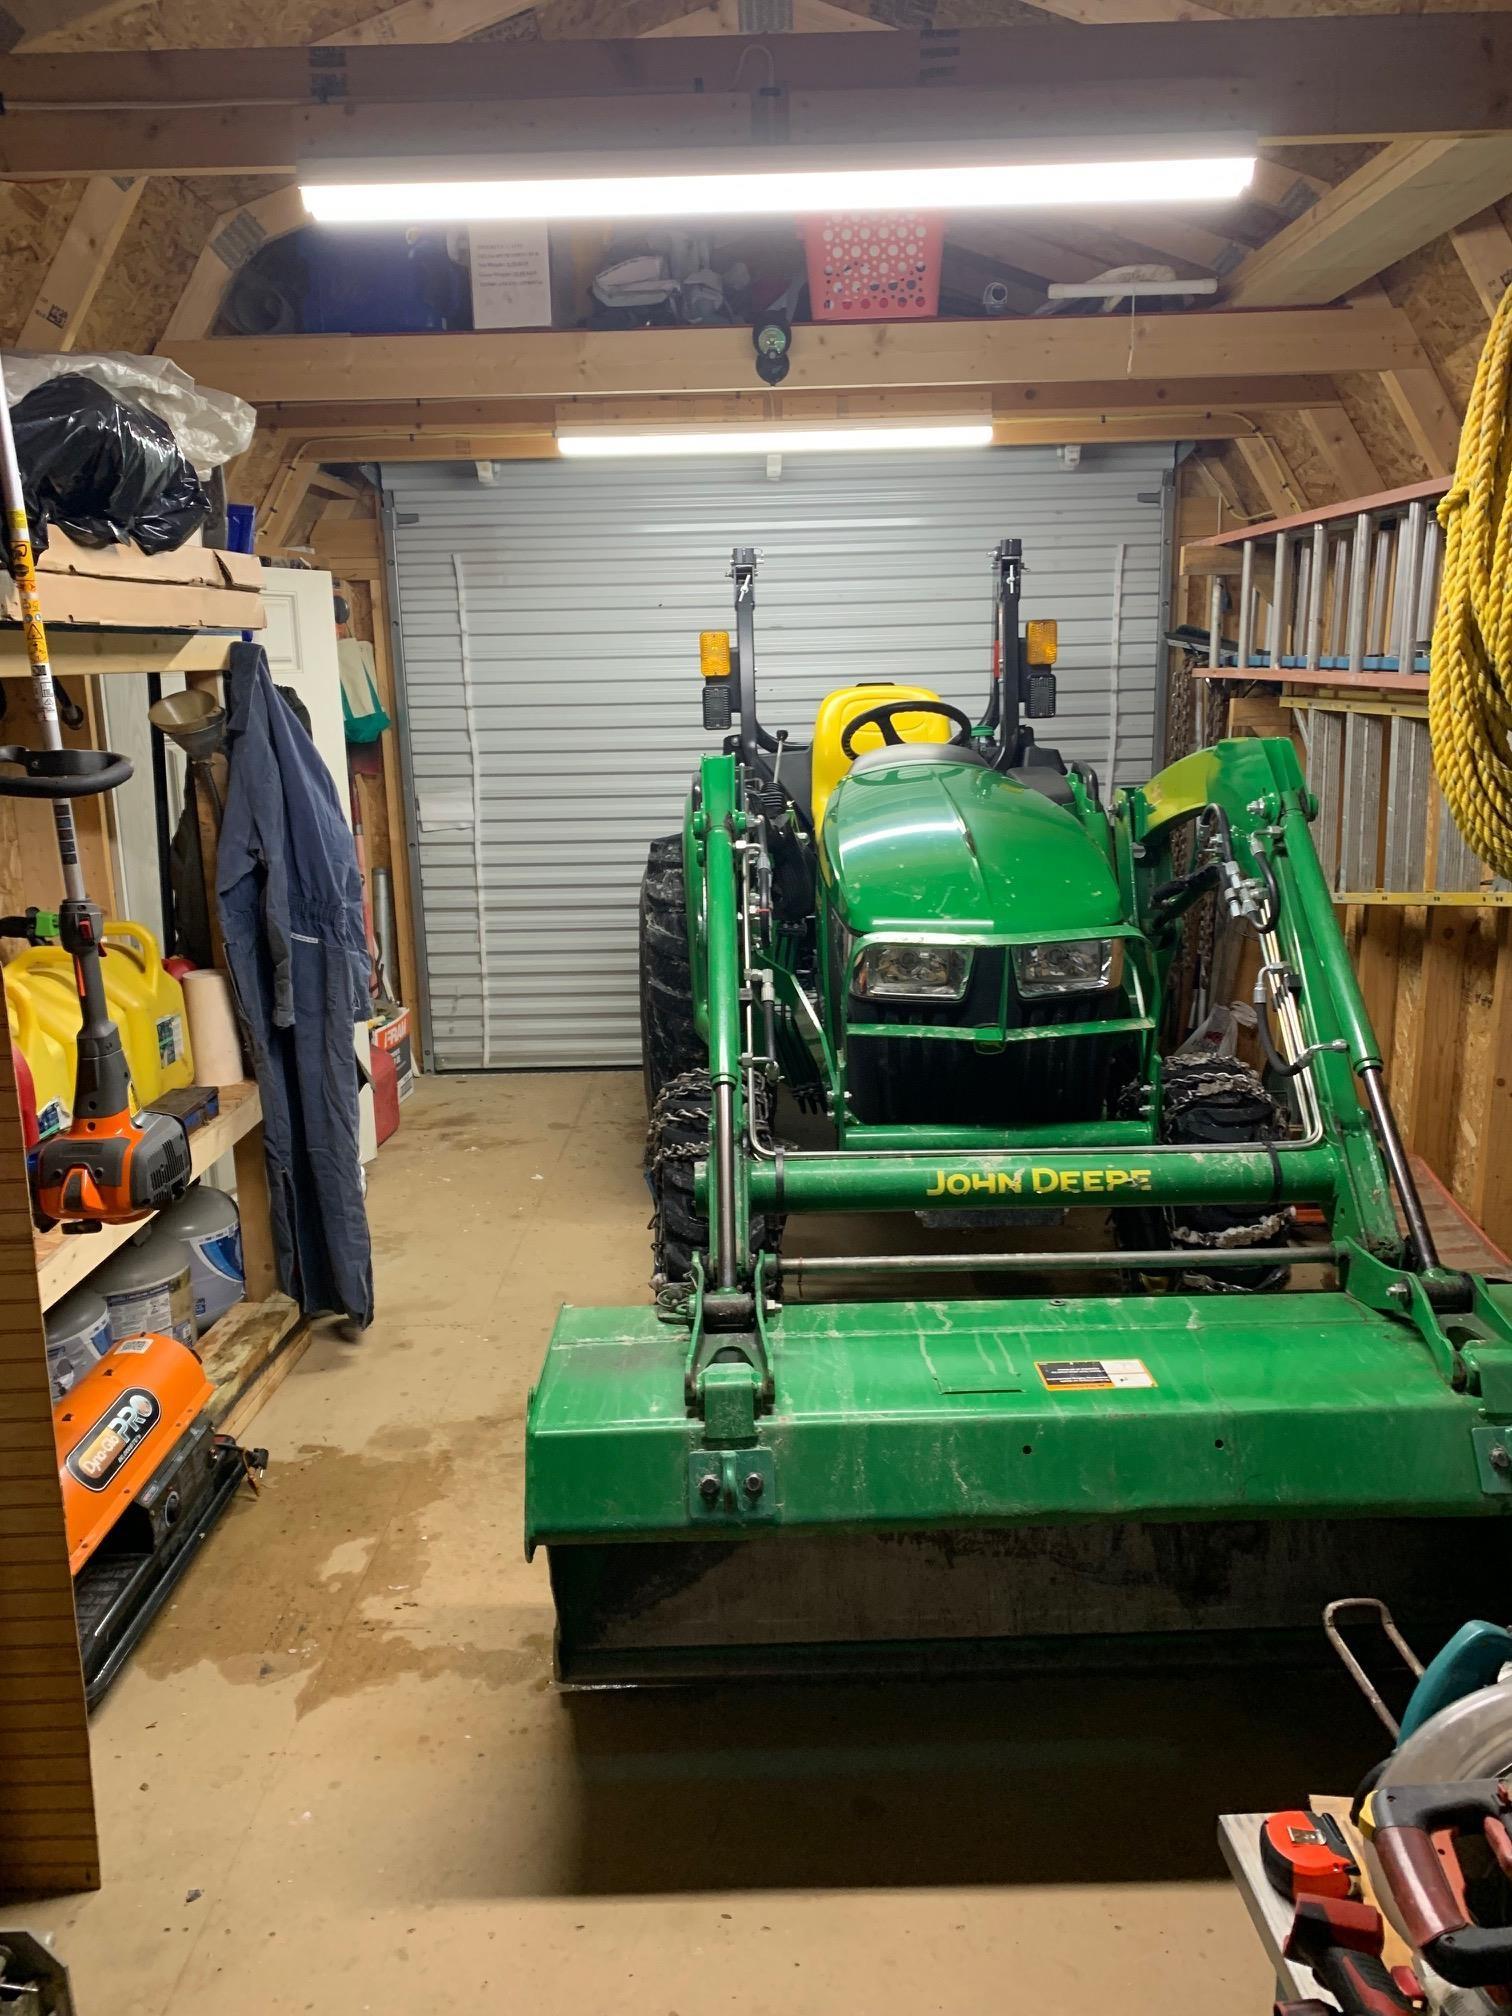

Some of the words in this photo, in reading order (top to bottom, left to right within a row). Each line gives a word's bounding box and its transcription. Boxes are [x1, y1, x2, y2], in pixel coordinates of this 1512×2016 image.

[927, 1168, 1023, 1196] JOHN
[84, 1434, 120, 1473] Dyna-Glo
[107, 1395, 153, 1444] PRO
